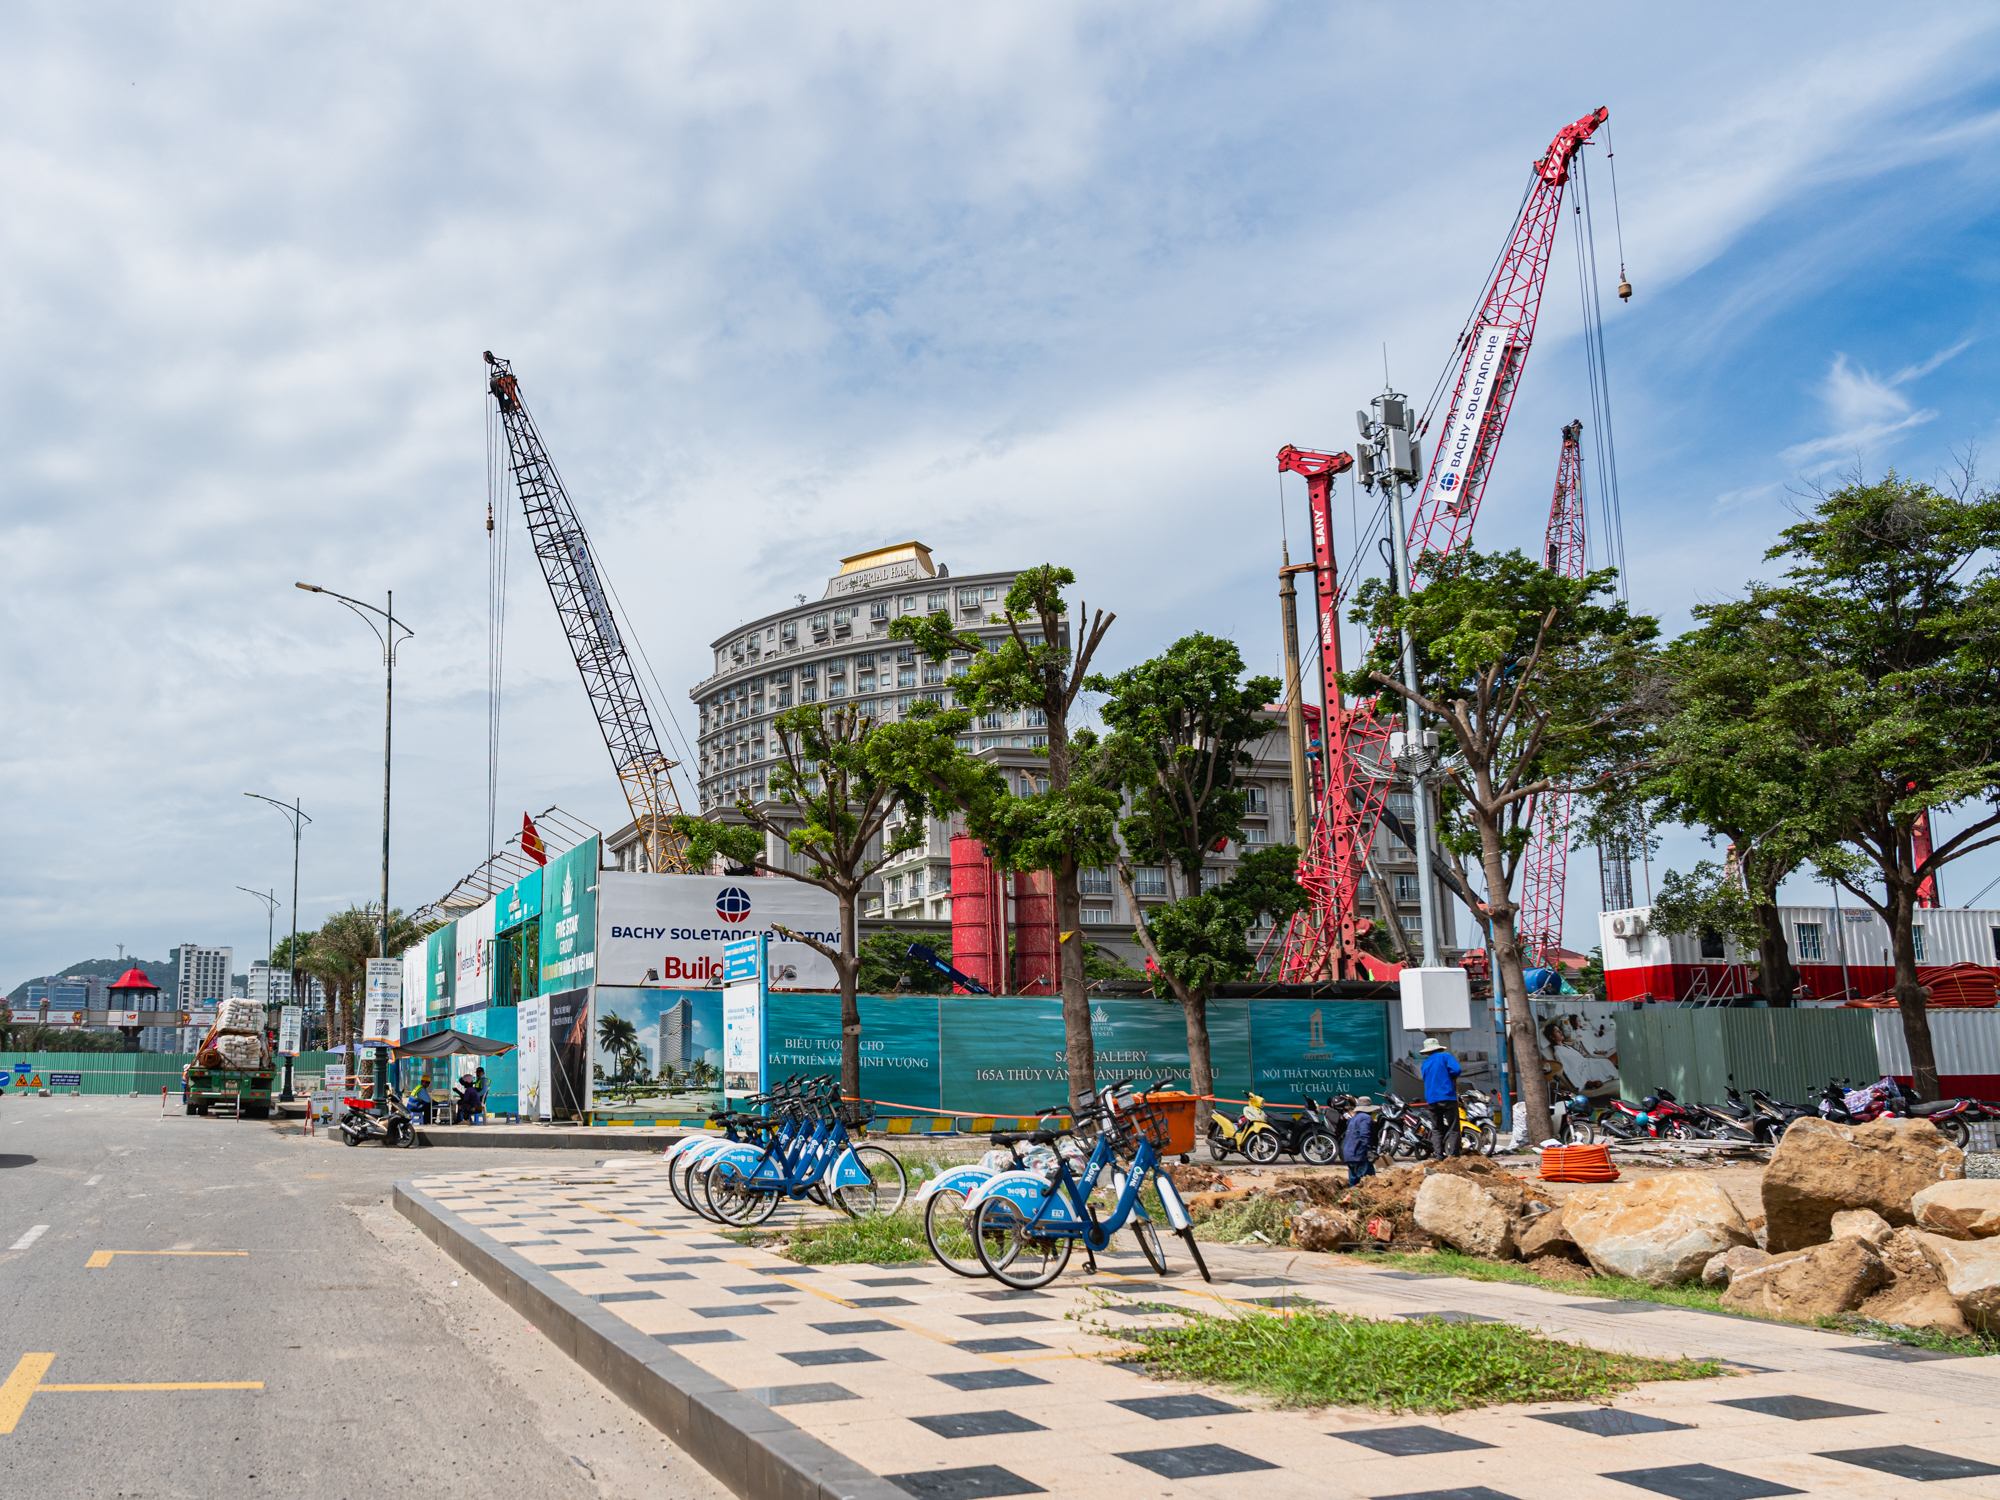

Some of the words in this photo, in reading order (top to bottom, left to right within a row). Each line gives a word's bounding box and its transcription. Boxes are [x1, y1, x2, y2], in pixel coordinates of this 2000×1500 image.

[1450, 424, 1471, 468] BACHY
[1313, 509, 1326, 546] SANY
[566, 915, 578, 936] STAR
[612, 926, 666, 940] BACHY
[586, 951, 594, 970] NAM
[665, 956, 723, 980] Build
[770, 964, 798, 982] us
[785, 1036, 812, 1049] BIỂU
[860, 1041, 884, 1051] CHO
[791, 1053, 826, 1065] TRIỂN
[888, 1057, 928, 1069] VƯỢNG
[1094, 1051, 1148, 1062] GALLERY
[976, 1070, 1004, 1080] 165A
[1006, 1066, 1043, 1081] THÙY
[1127, 1066, 1152, 1080] PHỐ
[1155, 1066, 1190, 1080] VŨNG
[1262, 1069, 1280, 1079] NỘI
[1282, 1067, 1308, 1078] THẤT
[1310, 1066, 1352, 1078] NGUYÊN
[1289, 1082, 1304, 1092] TỪ
[1305, 1082, 1334, 1092] CHÂU
[1337, 1082, 1350, 1092] ÂU
